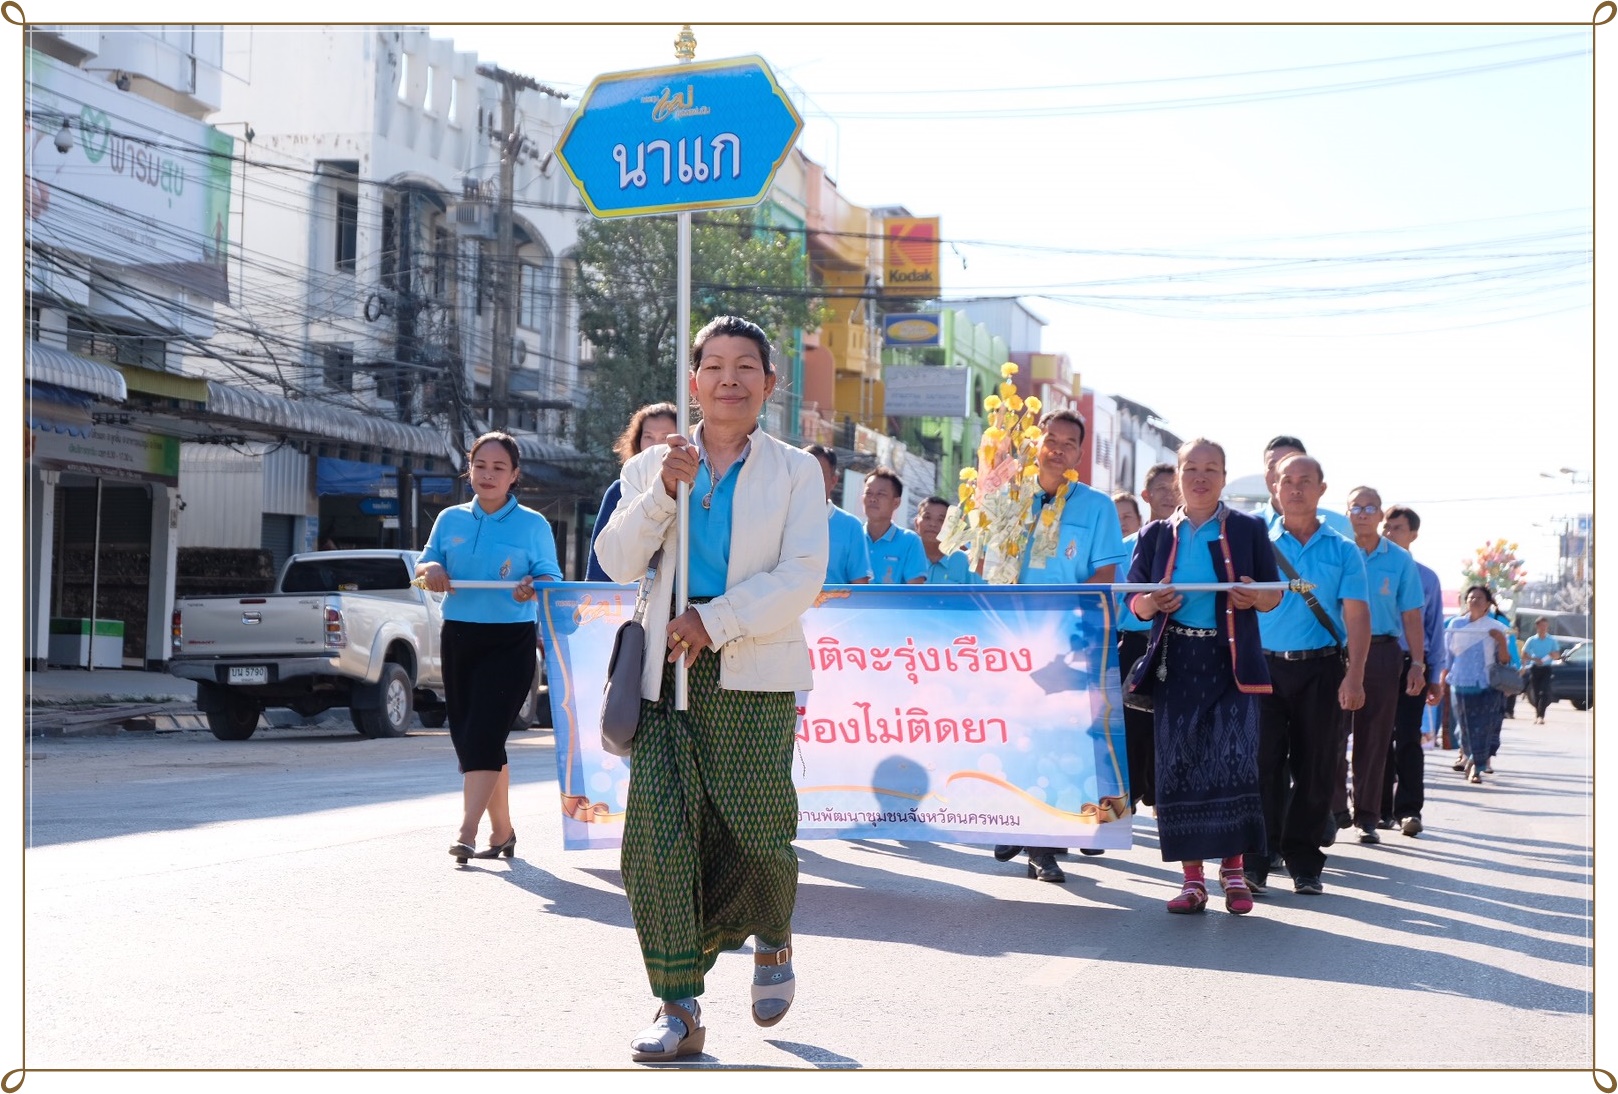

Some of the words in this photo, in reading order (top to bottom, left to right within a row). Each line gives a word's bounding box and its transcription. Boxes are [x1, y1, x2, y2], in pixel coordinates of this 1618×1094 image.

[611, 131, 742, 190] นาแก
[889, 269, 933, 283] Kodak
[245, 667, 264, 677] 5790
